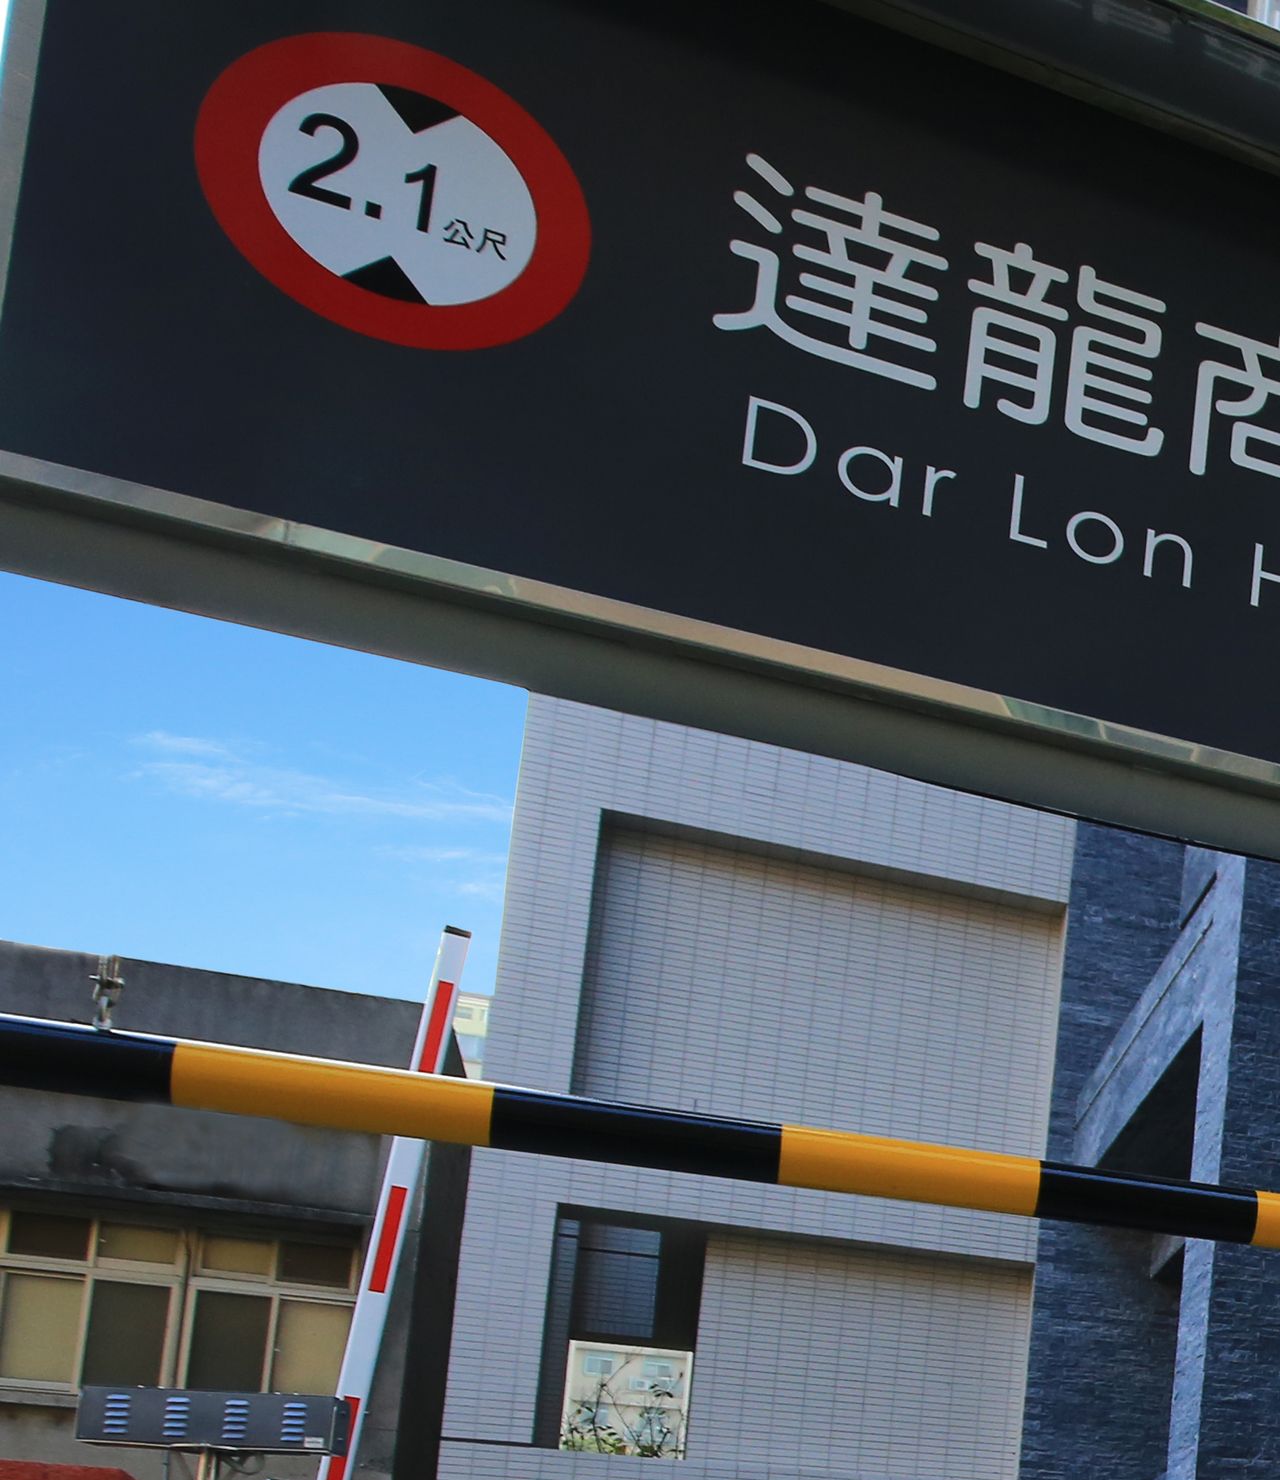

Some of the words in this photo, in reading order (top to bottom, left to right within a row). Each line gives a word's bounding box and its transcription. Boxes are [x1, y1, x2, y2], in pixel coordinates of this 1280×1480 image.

[287, 112, 438, 233] 2.1
[443, 218, 507, 261] 公尺
[741, 395, 957, 518] Dar
[1009, 473, 1193, 590] Lon
